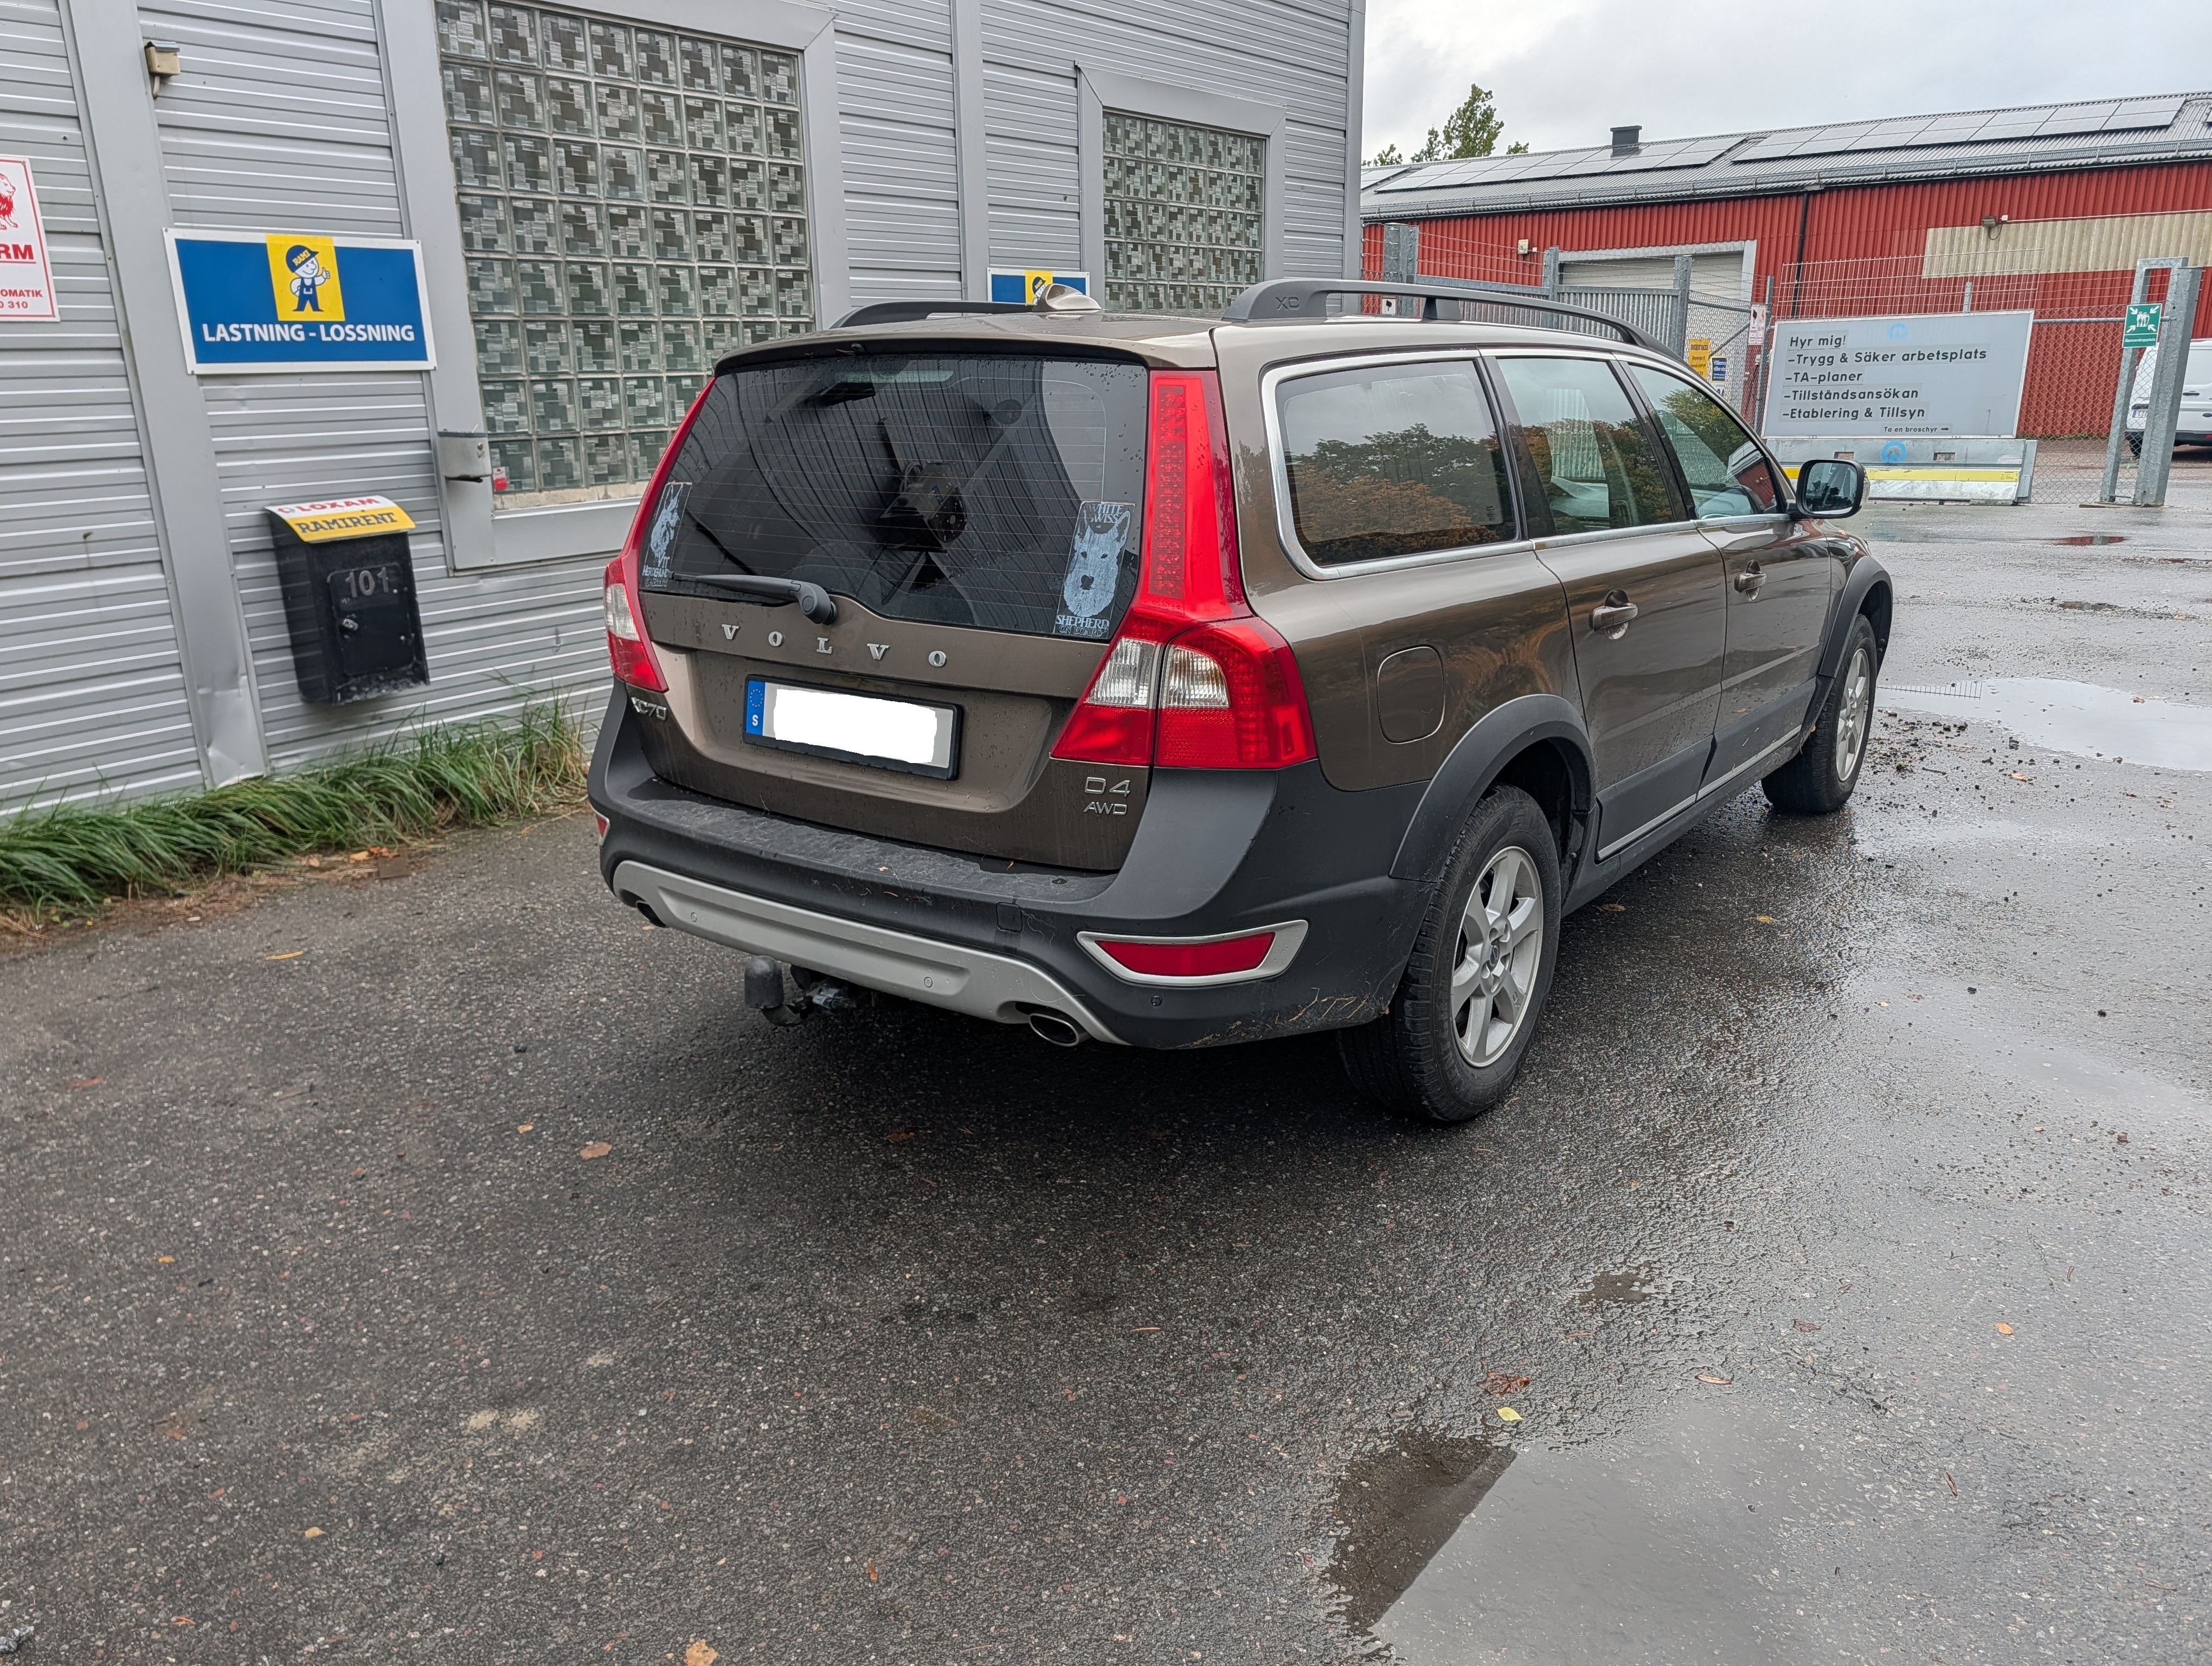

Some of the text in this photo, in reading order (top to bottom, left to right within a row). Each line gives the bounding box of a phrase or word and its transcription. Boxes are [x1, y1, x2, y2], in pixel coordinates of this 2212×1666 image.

[292, 249, 311, 266] RAMI
[1, 289, 43, 297] OMATIK
[8, 300, 28, 309] 310
[1275, 297, 1300, 311] XC
[202, 323, 305, 342] LASTNING
[319, 324, 415, 342] LOSSNING
[1790, 335, 1846, 349] Hyr mig!
[1840, 353, 1848, 363] &
[1854, 351, 1896, 362] Säker
[1902, 349, 1986, 362] arbetsplats
[1864, 407, 1873, 418] &
[1880, 407, 1925, 419] Tillsyn
[295, 497, 380, 512] LOXAM
[295, 512, 398, 533] RAMIRENT
[1090, 513, 1118, 523] WISS
[345, 567, 389, 598] 101
[1056, 614, 1109, 629] SHEPHERD
[1059, 625, 1103, 637] ON BOARD
[722, 623, 947, 668] VOLVO
[752, 714, 758, 726] S
[1084, 777, 1130, 797] D4
[1083, 802, 1127, 815] AWD
